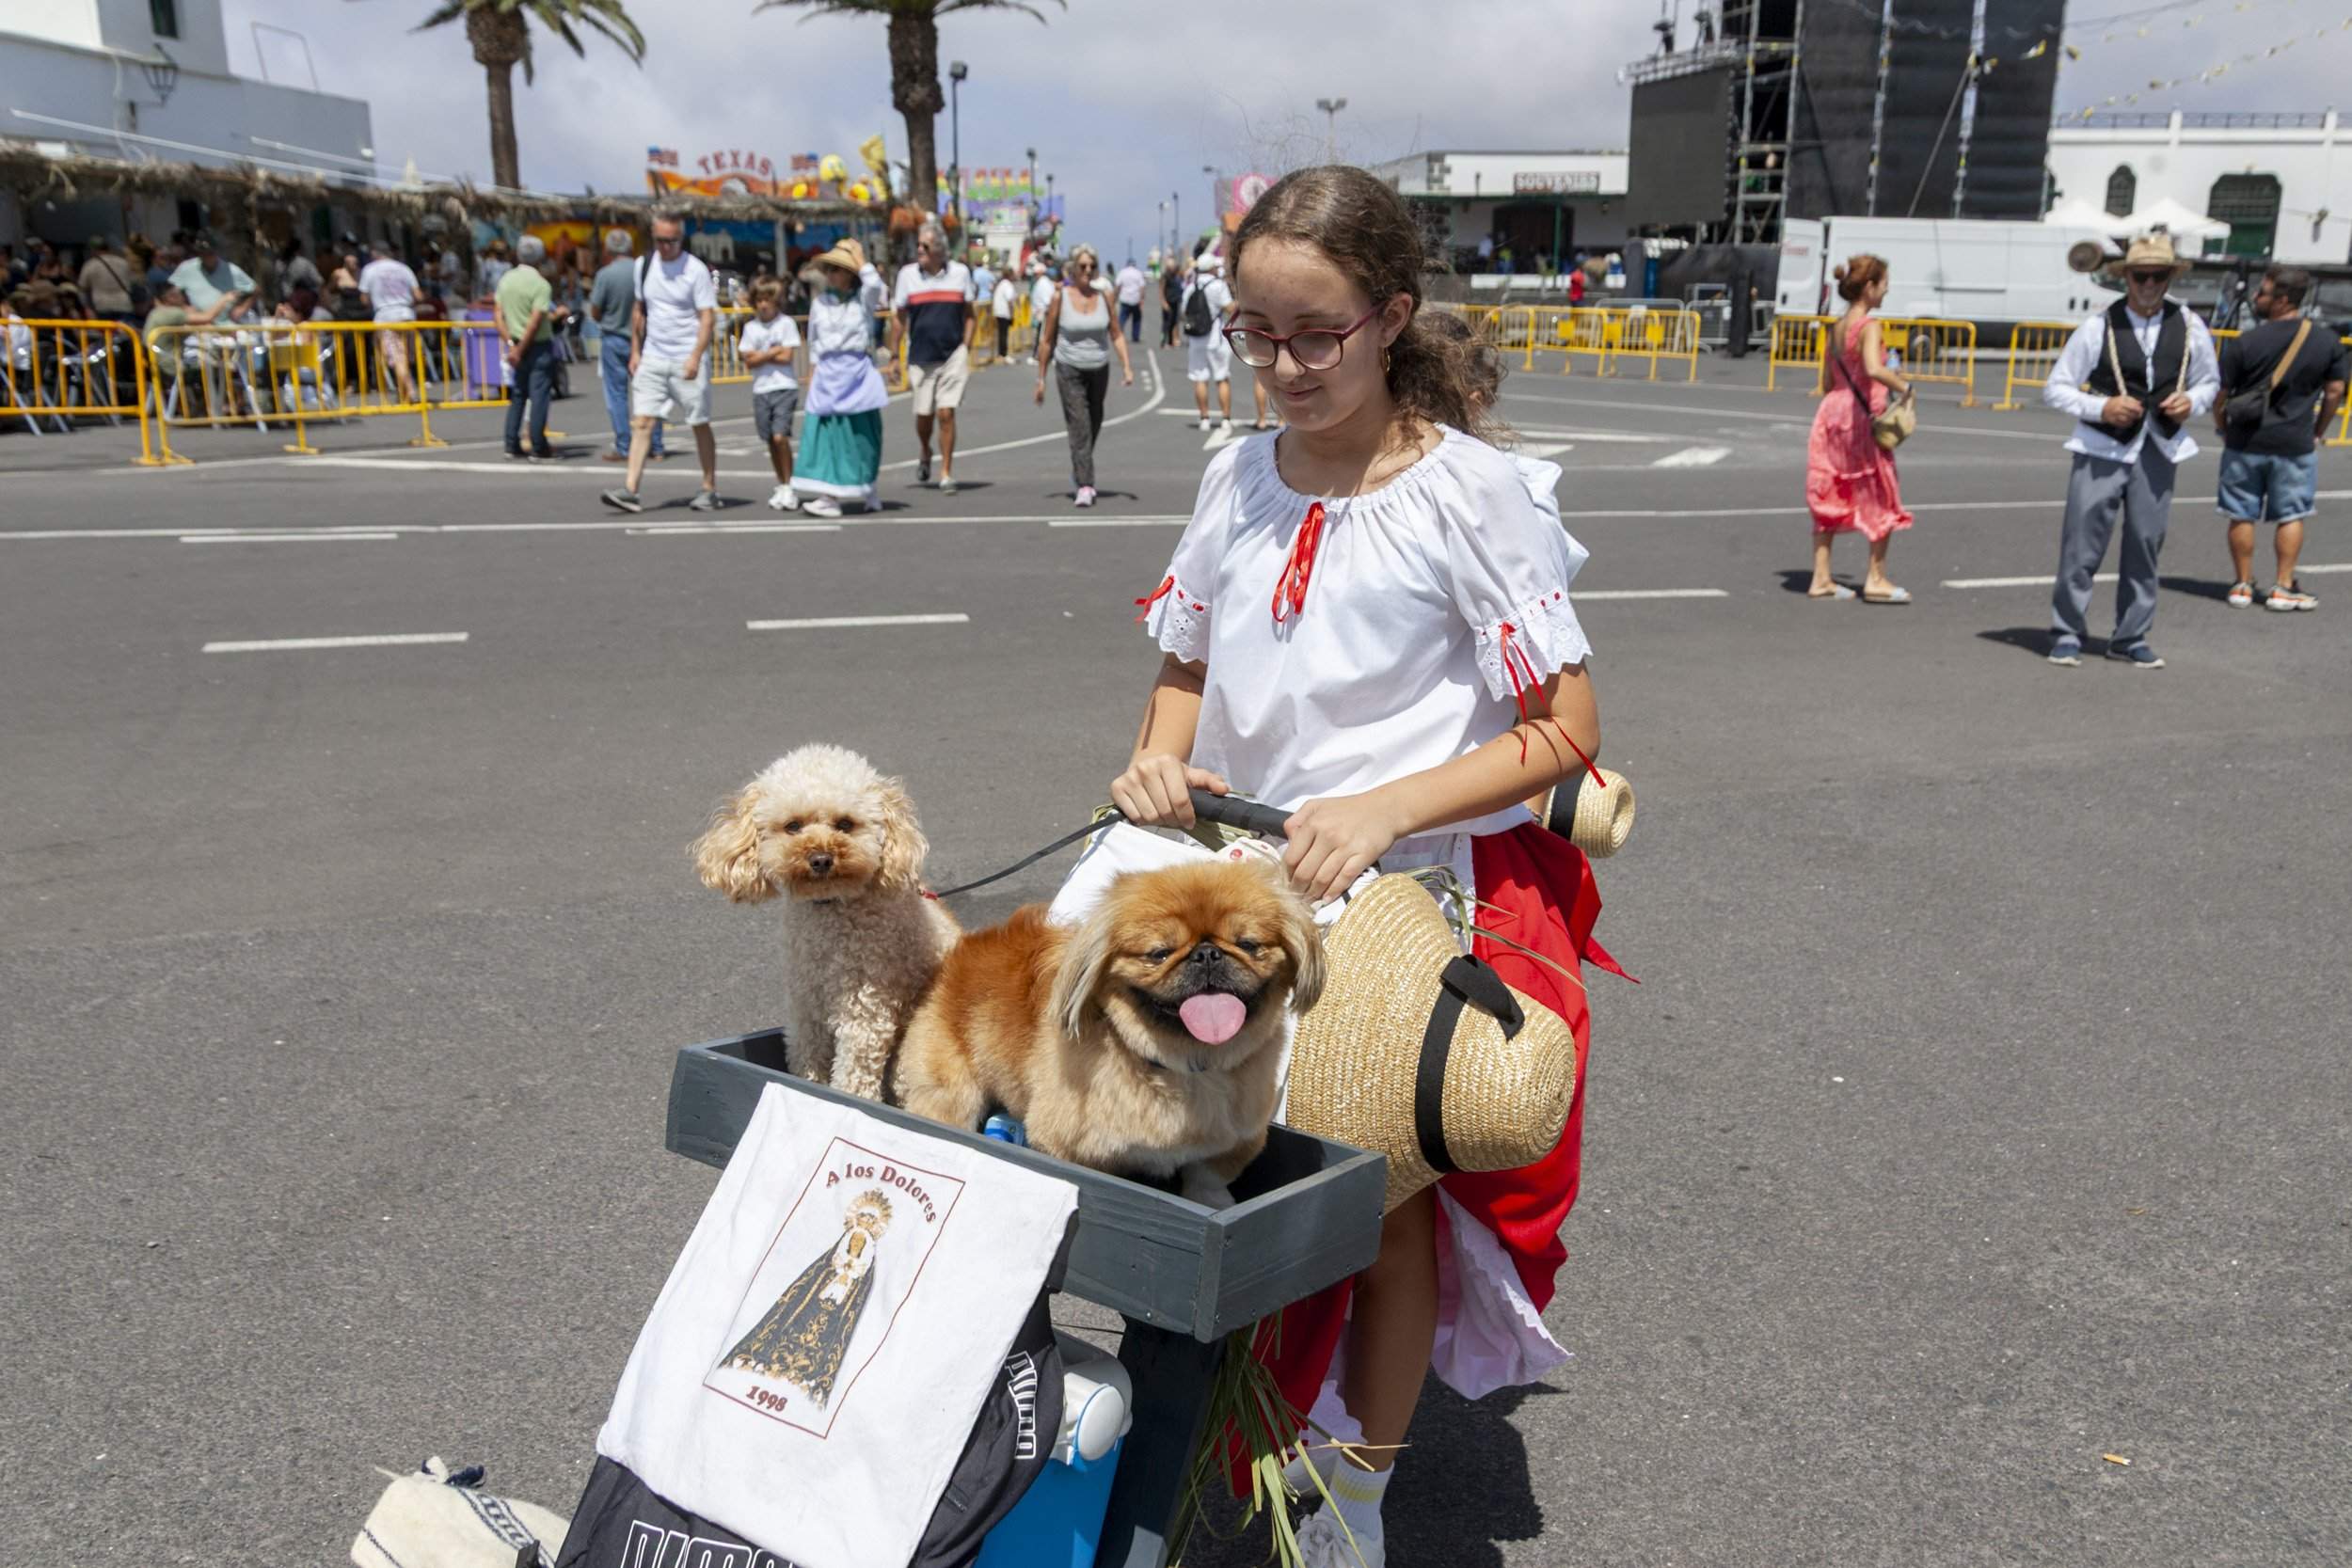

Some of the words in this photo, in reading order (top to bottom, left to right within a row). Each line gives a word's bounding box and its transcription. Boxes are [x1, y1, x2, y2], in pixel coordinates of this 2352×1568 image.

[697, 150, 772, 176] TEXAS
[826, 1170, 840, 1188] A
[845, 1163, 875, 1179] los
[880, 1165, 937, 1223] Dolores
[746, 1386, 788, 1412] 1998
